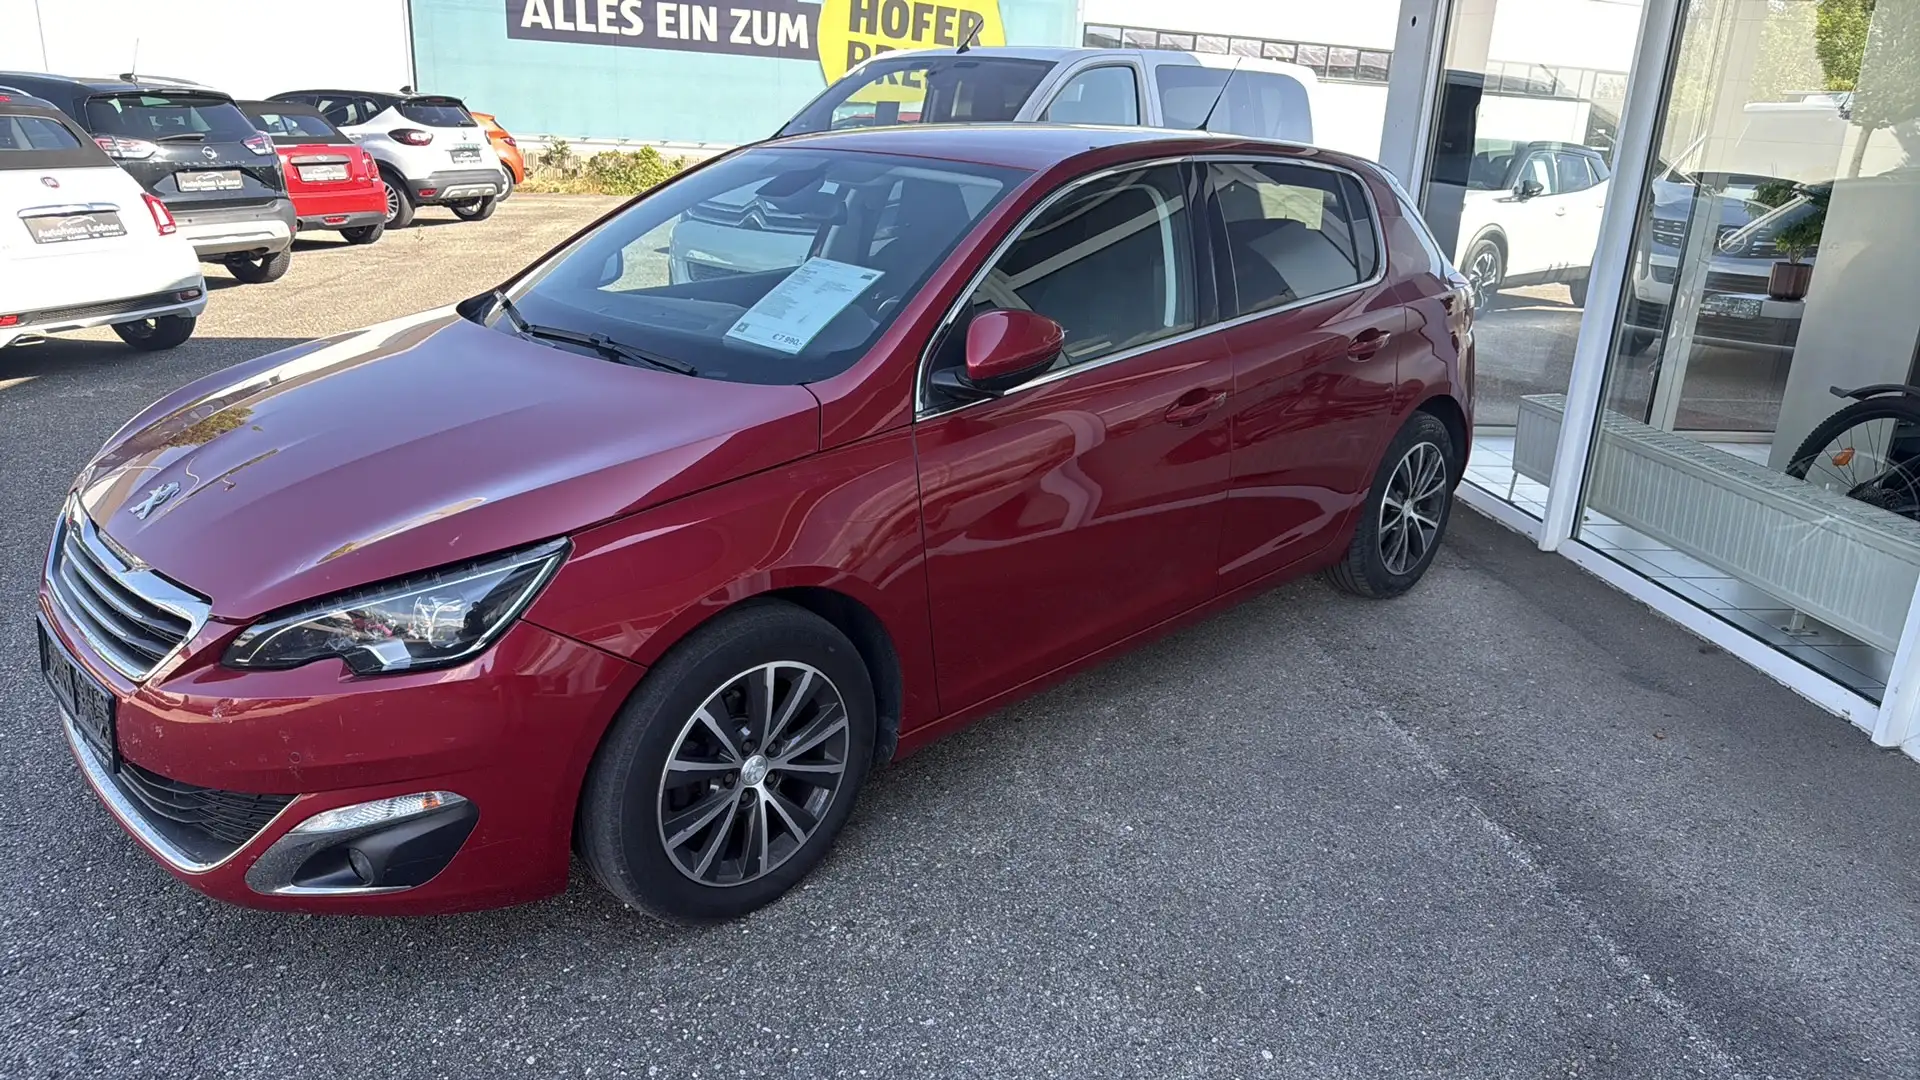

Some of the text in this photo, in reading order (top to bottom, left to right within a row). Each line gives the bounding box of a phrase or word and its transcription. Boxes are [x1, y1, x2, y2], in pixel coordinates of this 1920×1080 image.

[521, 0, 809, 48] ALLES EIN ZUM
[849, 0, 984, 46] HOFER
[38, 225, 88, 238] Autohaus
